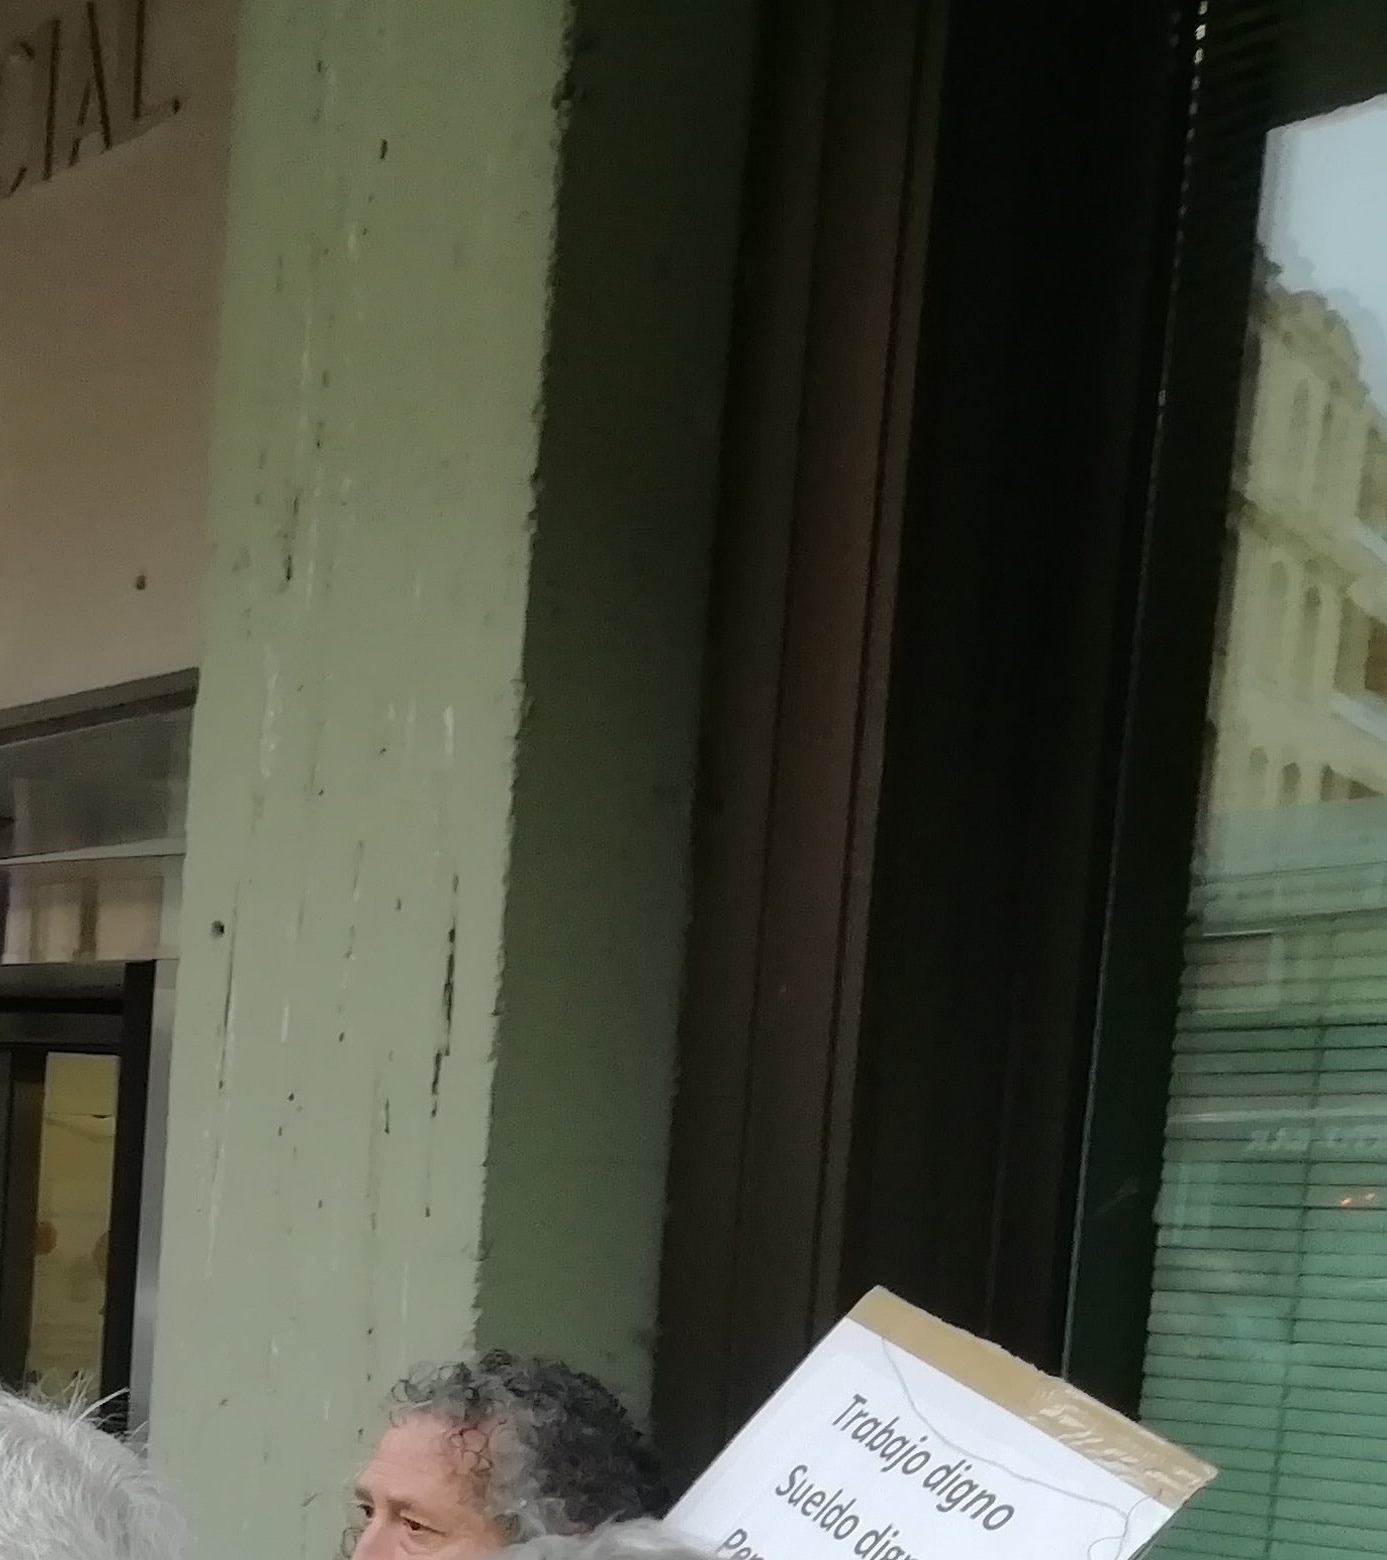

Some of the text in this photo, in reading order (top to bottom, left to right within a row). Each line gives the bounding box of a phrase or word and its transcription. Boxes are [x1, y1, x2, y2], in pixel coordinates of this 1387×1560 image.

[775, 1464, 860, 1541] Sueldo
[832, 1393, 1016, 1531] Trabajo digno
